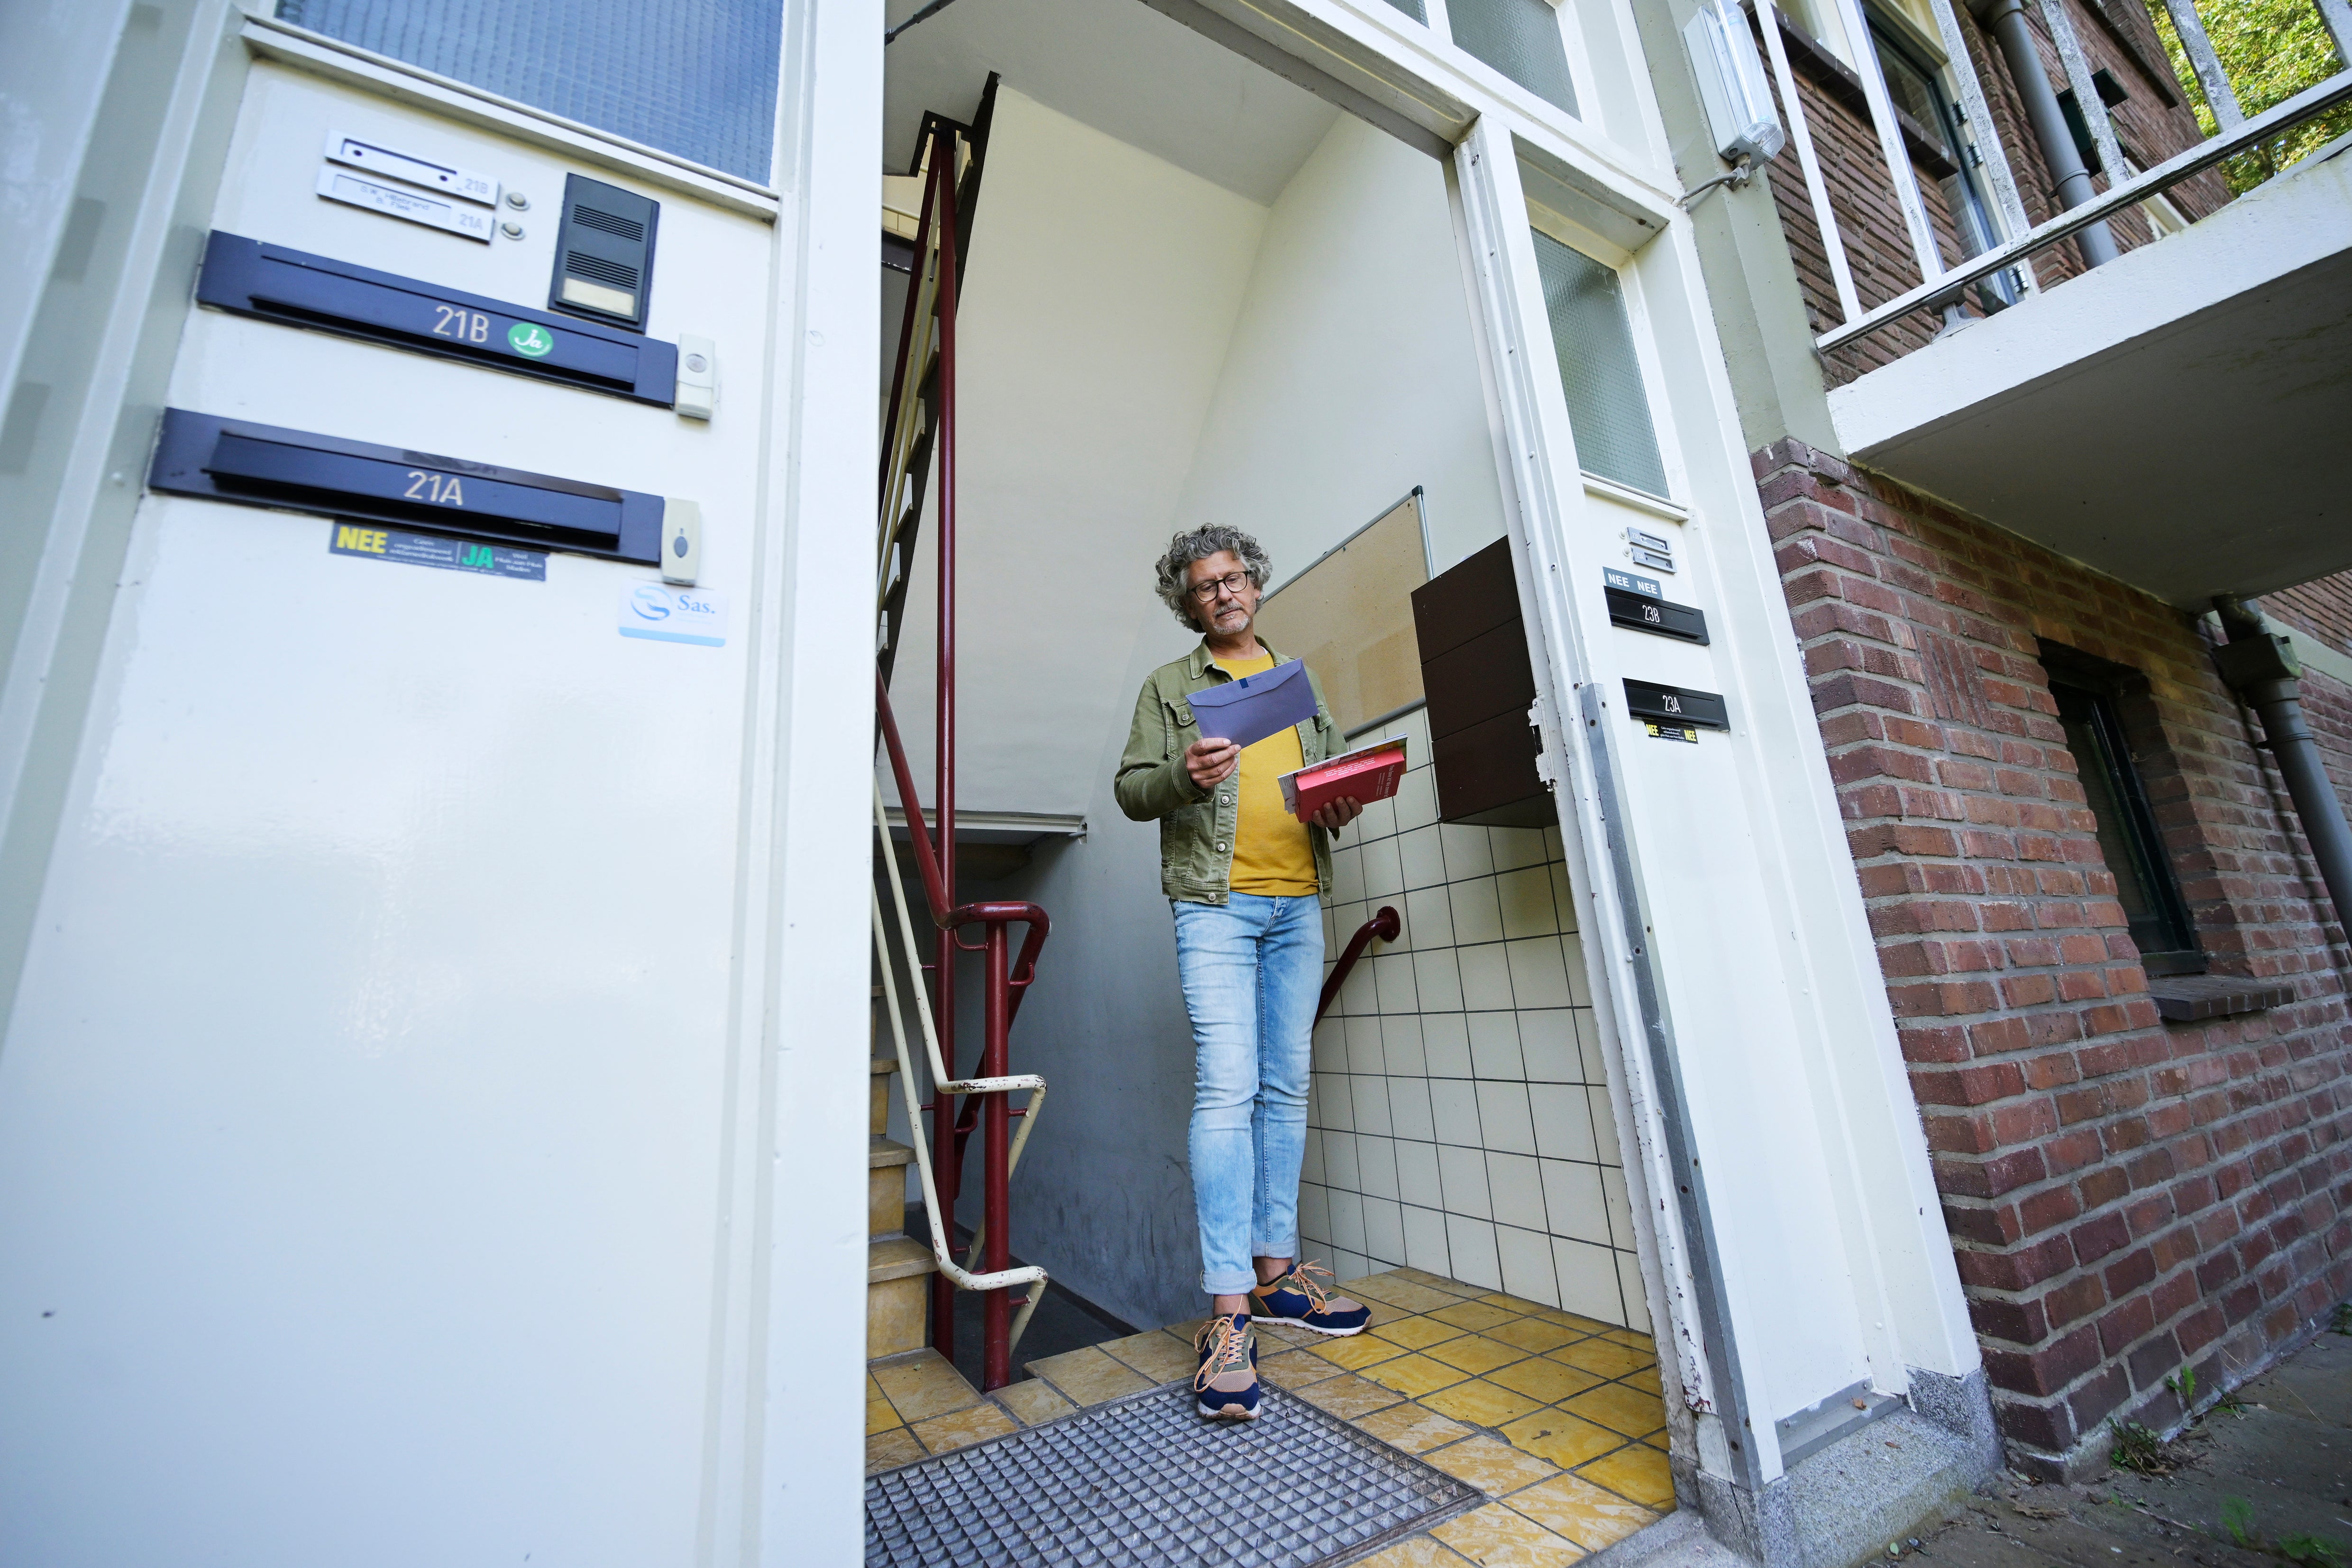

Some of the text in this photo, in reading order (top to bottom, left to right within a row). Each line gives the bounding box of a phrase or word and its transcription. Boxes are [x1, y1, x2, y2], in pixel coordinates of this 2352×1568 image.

[465, 178, 488, 193] 21B
[459, 214, 483, 230] 21A
[433, 305, 489, 343] 21B
[404, 471, 463, 506] 21A
[337, 526, 388, 554] NEE
[1631, 532, 1639, 540] 23B
[461, 545, 494, 569] JA
[1608, 573, 1658, 595] NEE NEE
[677, 595, 715, 614] Sas.
[1642, 605, 1660, 623] 23B
[1663, 695, 1681, 713] 23A
[1646, 724, 1659, 736] NEE
[1684, 729, 1697, 742] NEE
